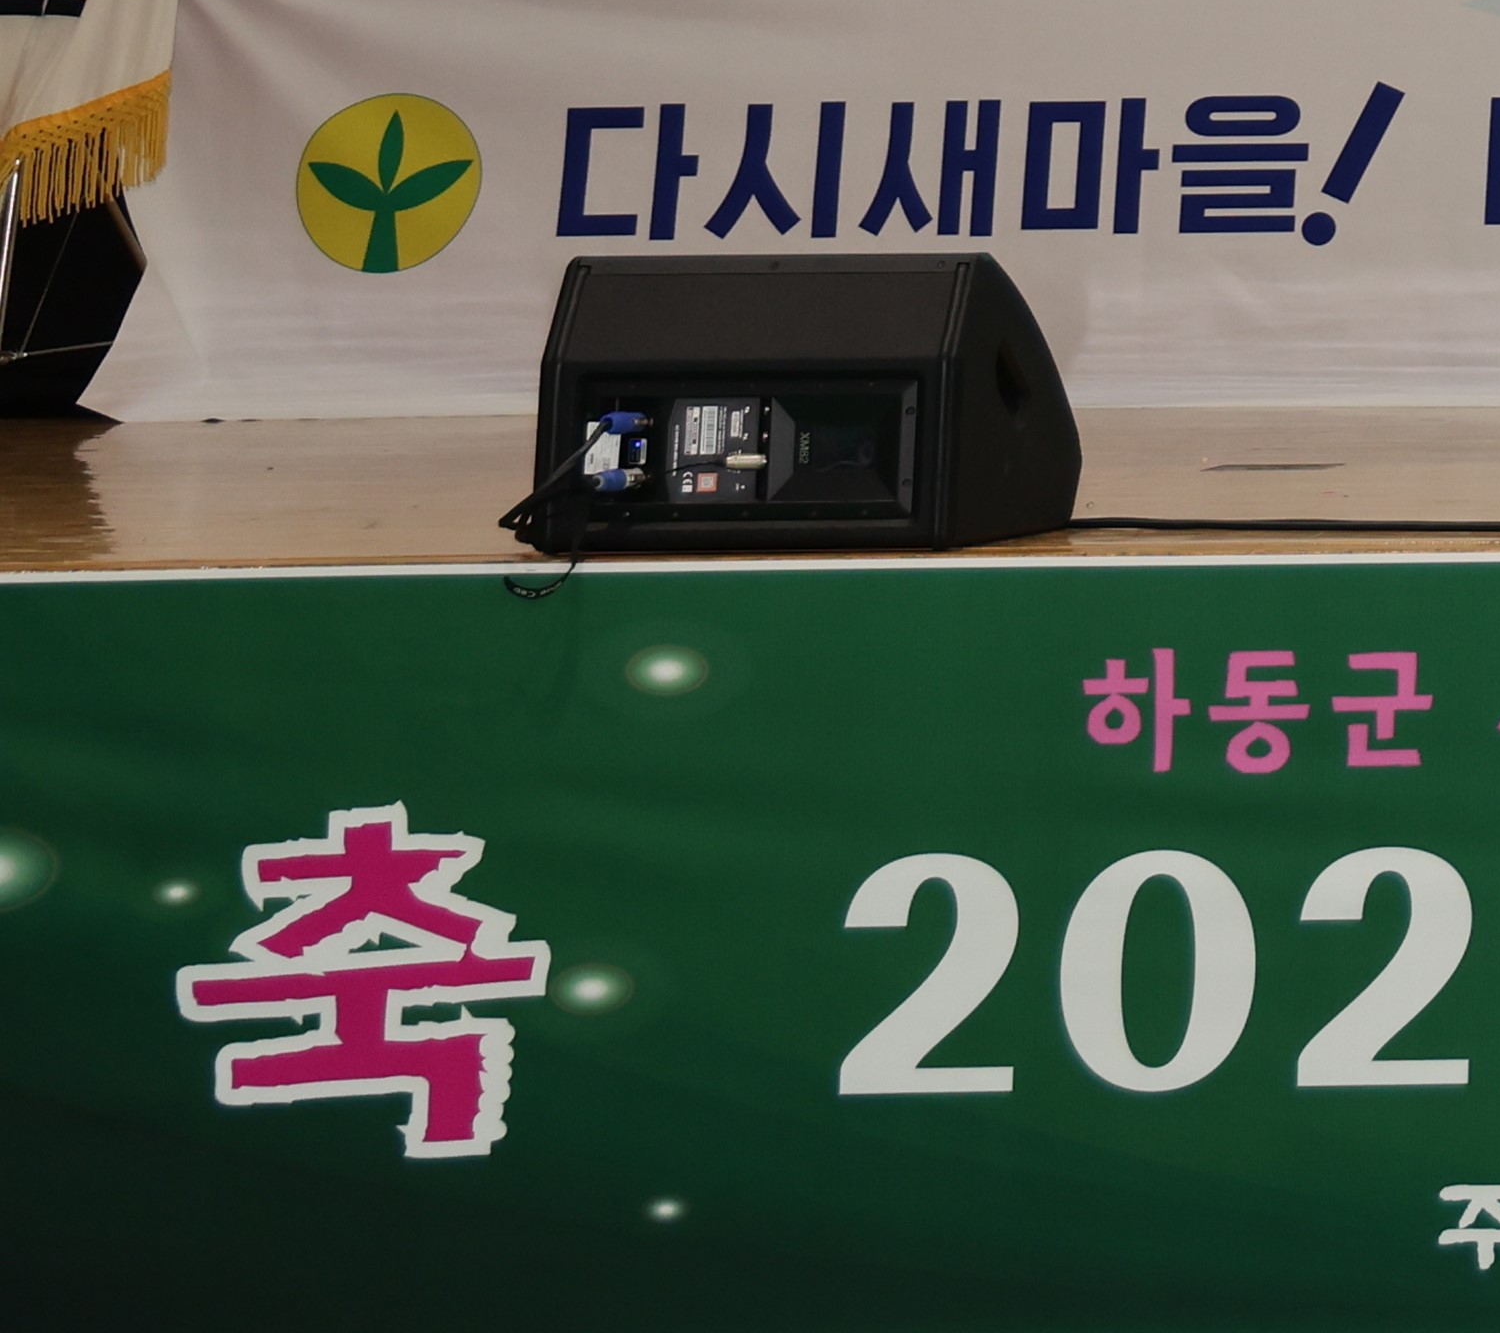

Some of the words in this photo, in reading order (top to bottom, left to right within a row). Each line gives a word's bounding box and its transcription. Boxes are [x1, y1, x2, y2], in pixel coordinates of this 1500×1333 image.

[555, 80, 1406, 247] 다시새마을!
[799, 431, 810, 465] XM82
[1083, 648, 1433, 774] 하동군
[176, 801, 551, 1160] 축
